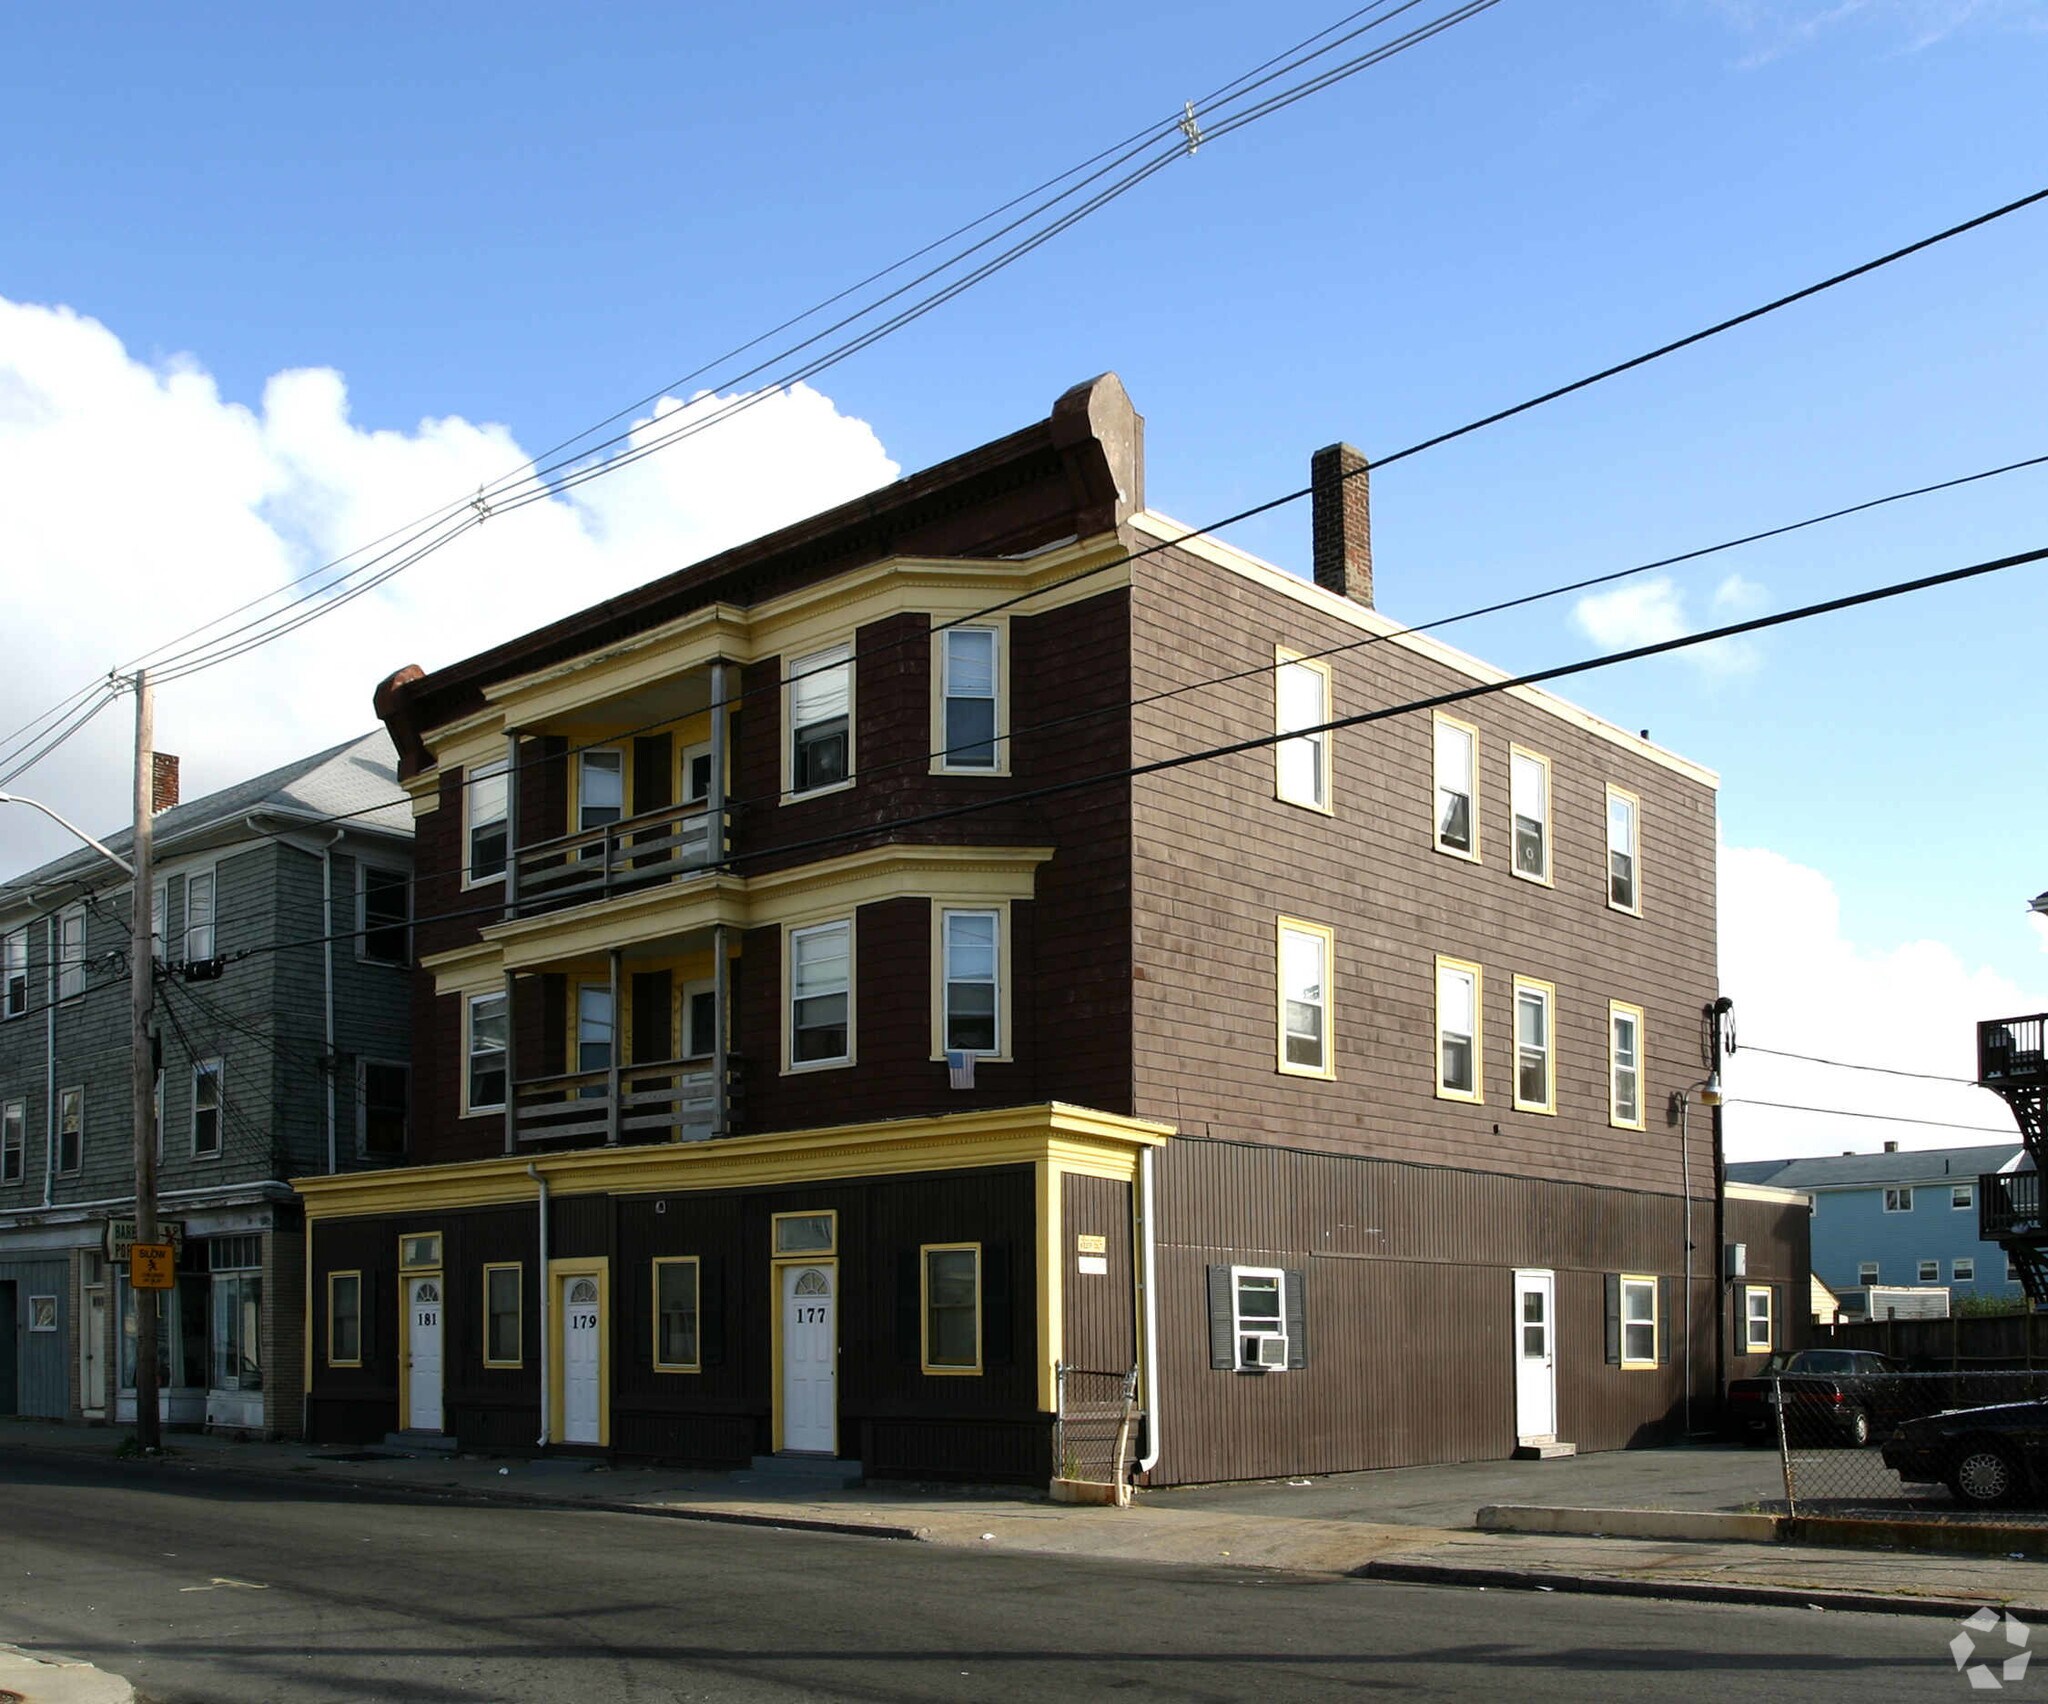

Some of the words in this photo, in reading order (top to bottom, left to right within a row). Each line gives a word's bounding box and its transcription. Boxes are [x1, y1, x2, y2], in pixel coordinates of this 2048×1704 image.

[139, 1248, 166, 1259] SLOW
[418, 1312, 437, 1326] 181
[573, 1314, 597, 1330] 179
[797, 1307, 826, 1324] 177
